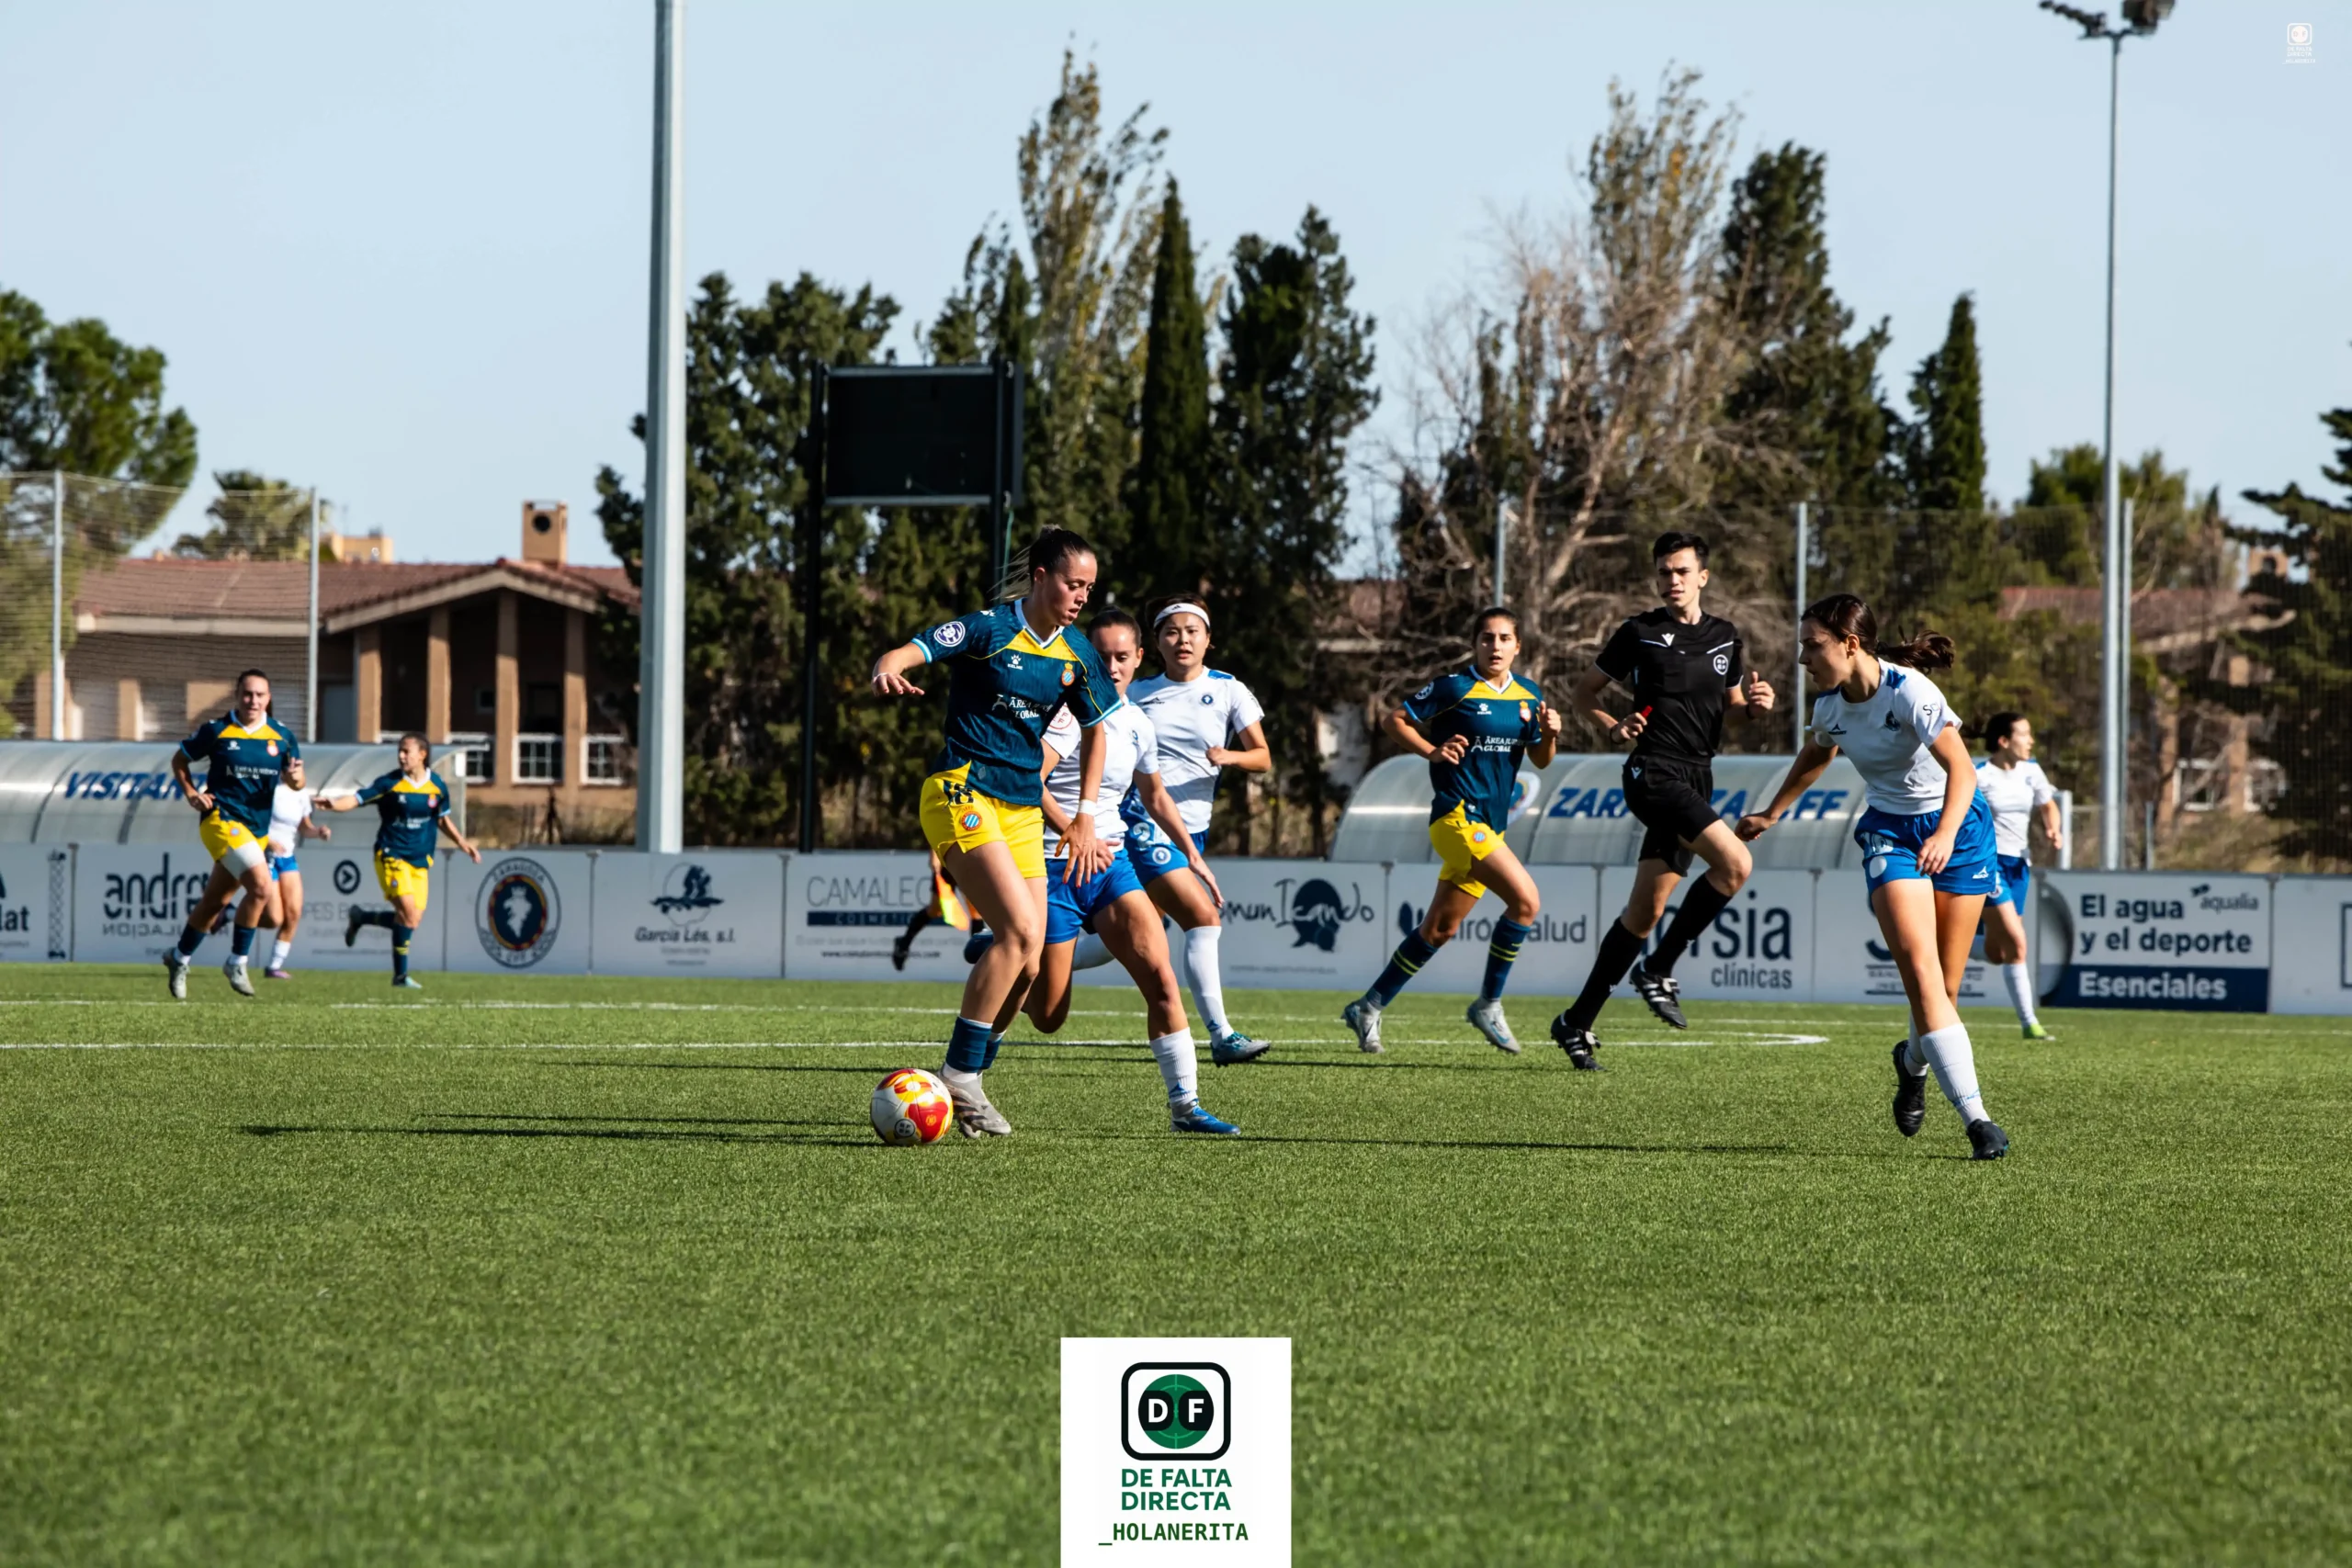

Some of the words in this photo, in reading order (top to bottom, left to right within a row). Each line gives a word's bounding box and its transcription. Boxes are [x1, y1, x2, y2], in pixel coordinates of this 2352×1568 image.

[64, 772, 208, 800] VISITANT
[2080, 894, 2106, 919] El
[2115, 899, 2184, 924] agua
[2080, 931, 2097, 955] y
[2105, 926, 2130, 951] el
[2138, 927, 2252, 957] deporte
[2078, 971, 2228, 1001] Esenciales
